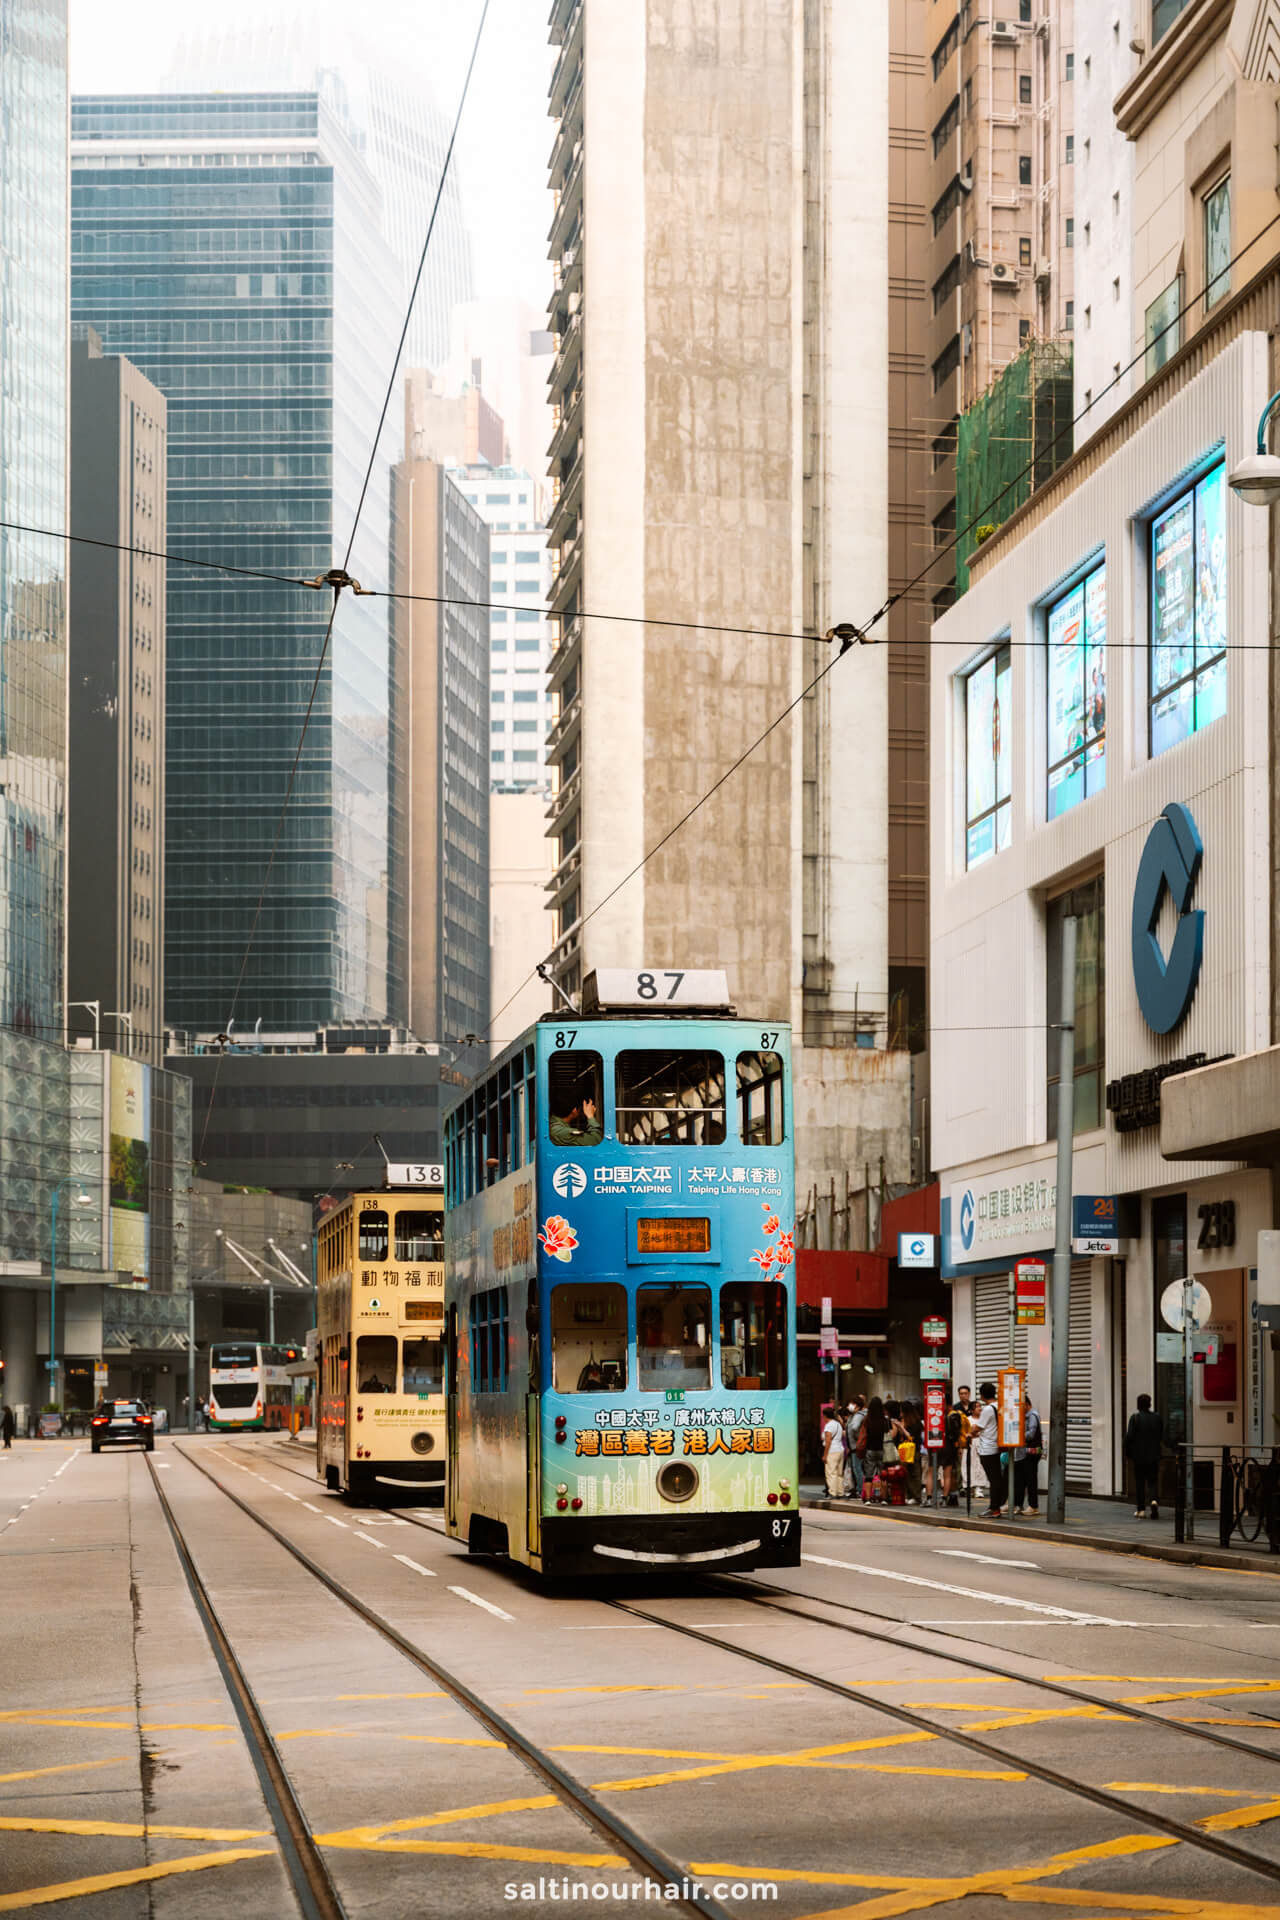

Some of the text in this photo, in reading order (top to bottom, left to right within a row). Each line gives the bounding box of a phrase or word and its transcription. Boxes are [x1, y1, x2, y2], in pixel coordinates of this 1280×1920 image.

[637, 973, 685, 1000] 87
[555, 1030, 577, 1048] 87
[760, 1033, 779, 1050] 87
[406, 1167, 442, 1182] 138
[594, 1166, 672, 1183] 中国太平
[688, 1167, 782, 1183] 太平人壽(香港)
[594, 1185, 672, 1194] CHINA TAIPING
[688, 1185, 782, 1197] Taiping Life Hong Kong
[363, 1200, 378, 1210] 138
[1198, 1201, 1235, 1249] 238
[361, 1270, 443, 1287] 動物福利
[575, 1427, 775, 1456] 灣區養老 港人家園
[772, 1519, 791, 1537] 87
